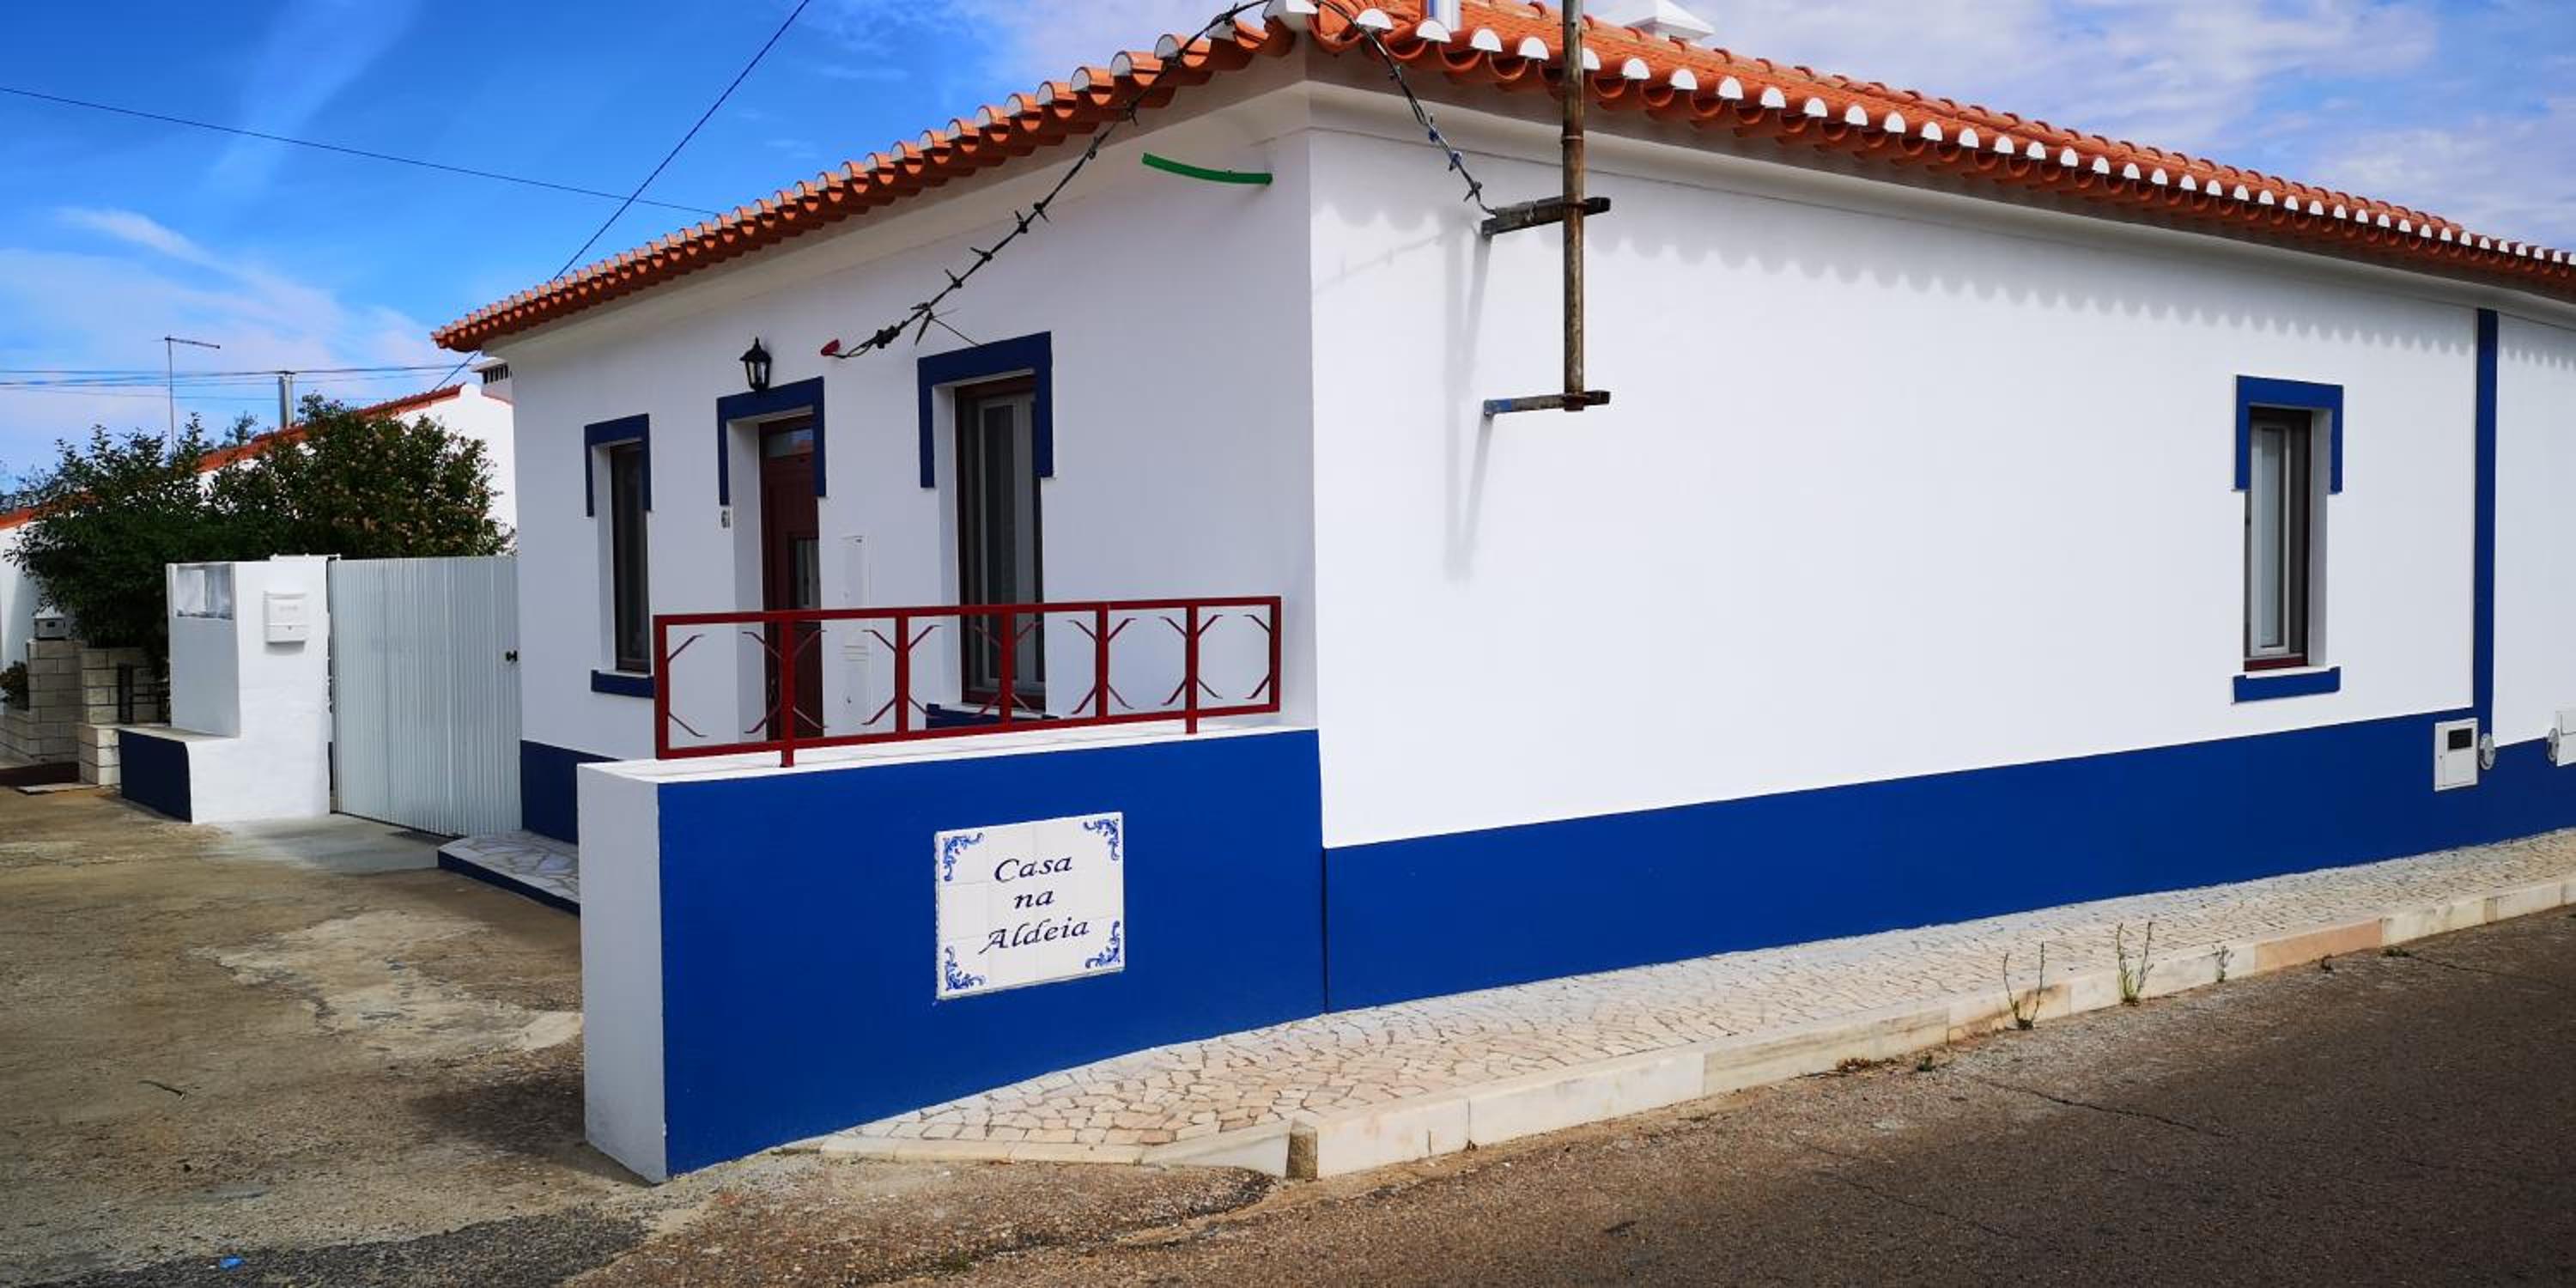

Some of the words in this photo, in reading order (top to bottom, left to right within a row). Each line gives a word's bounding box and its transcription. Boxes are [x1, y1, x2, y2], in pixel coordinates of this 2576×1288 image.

[994, 856, 1072, 884] Casa
[1013, 890, 1054, 909] na
[977, 917, 1090, 955] Aldeia
